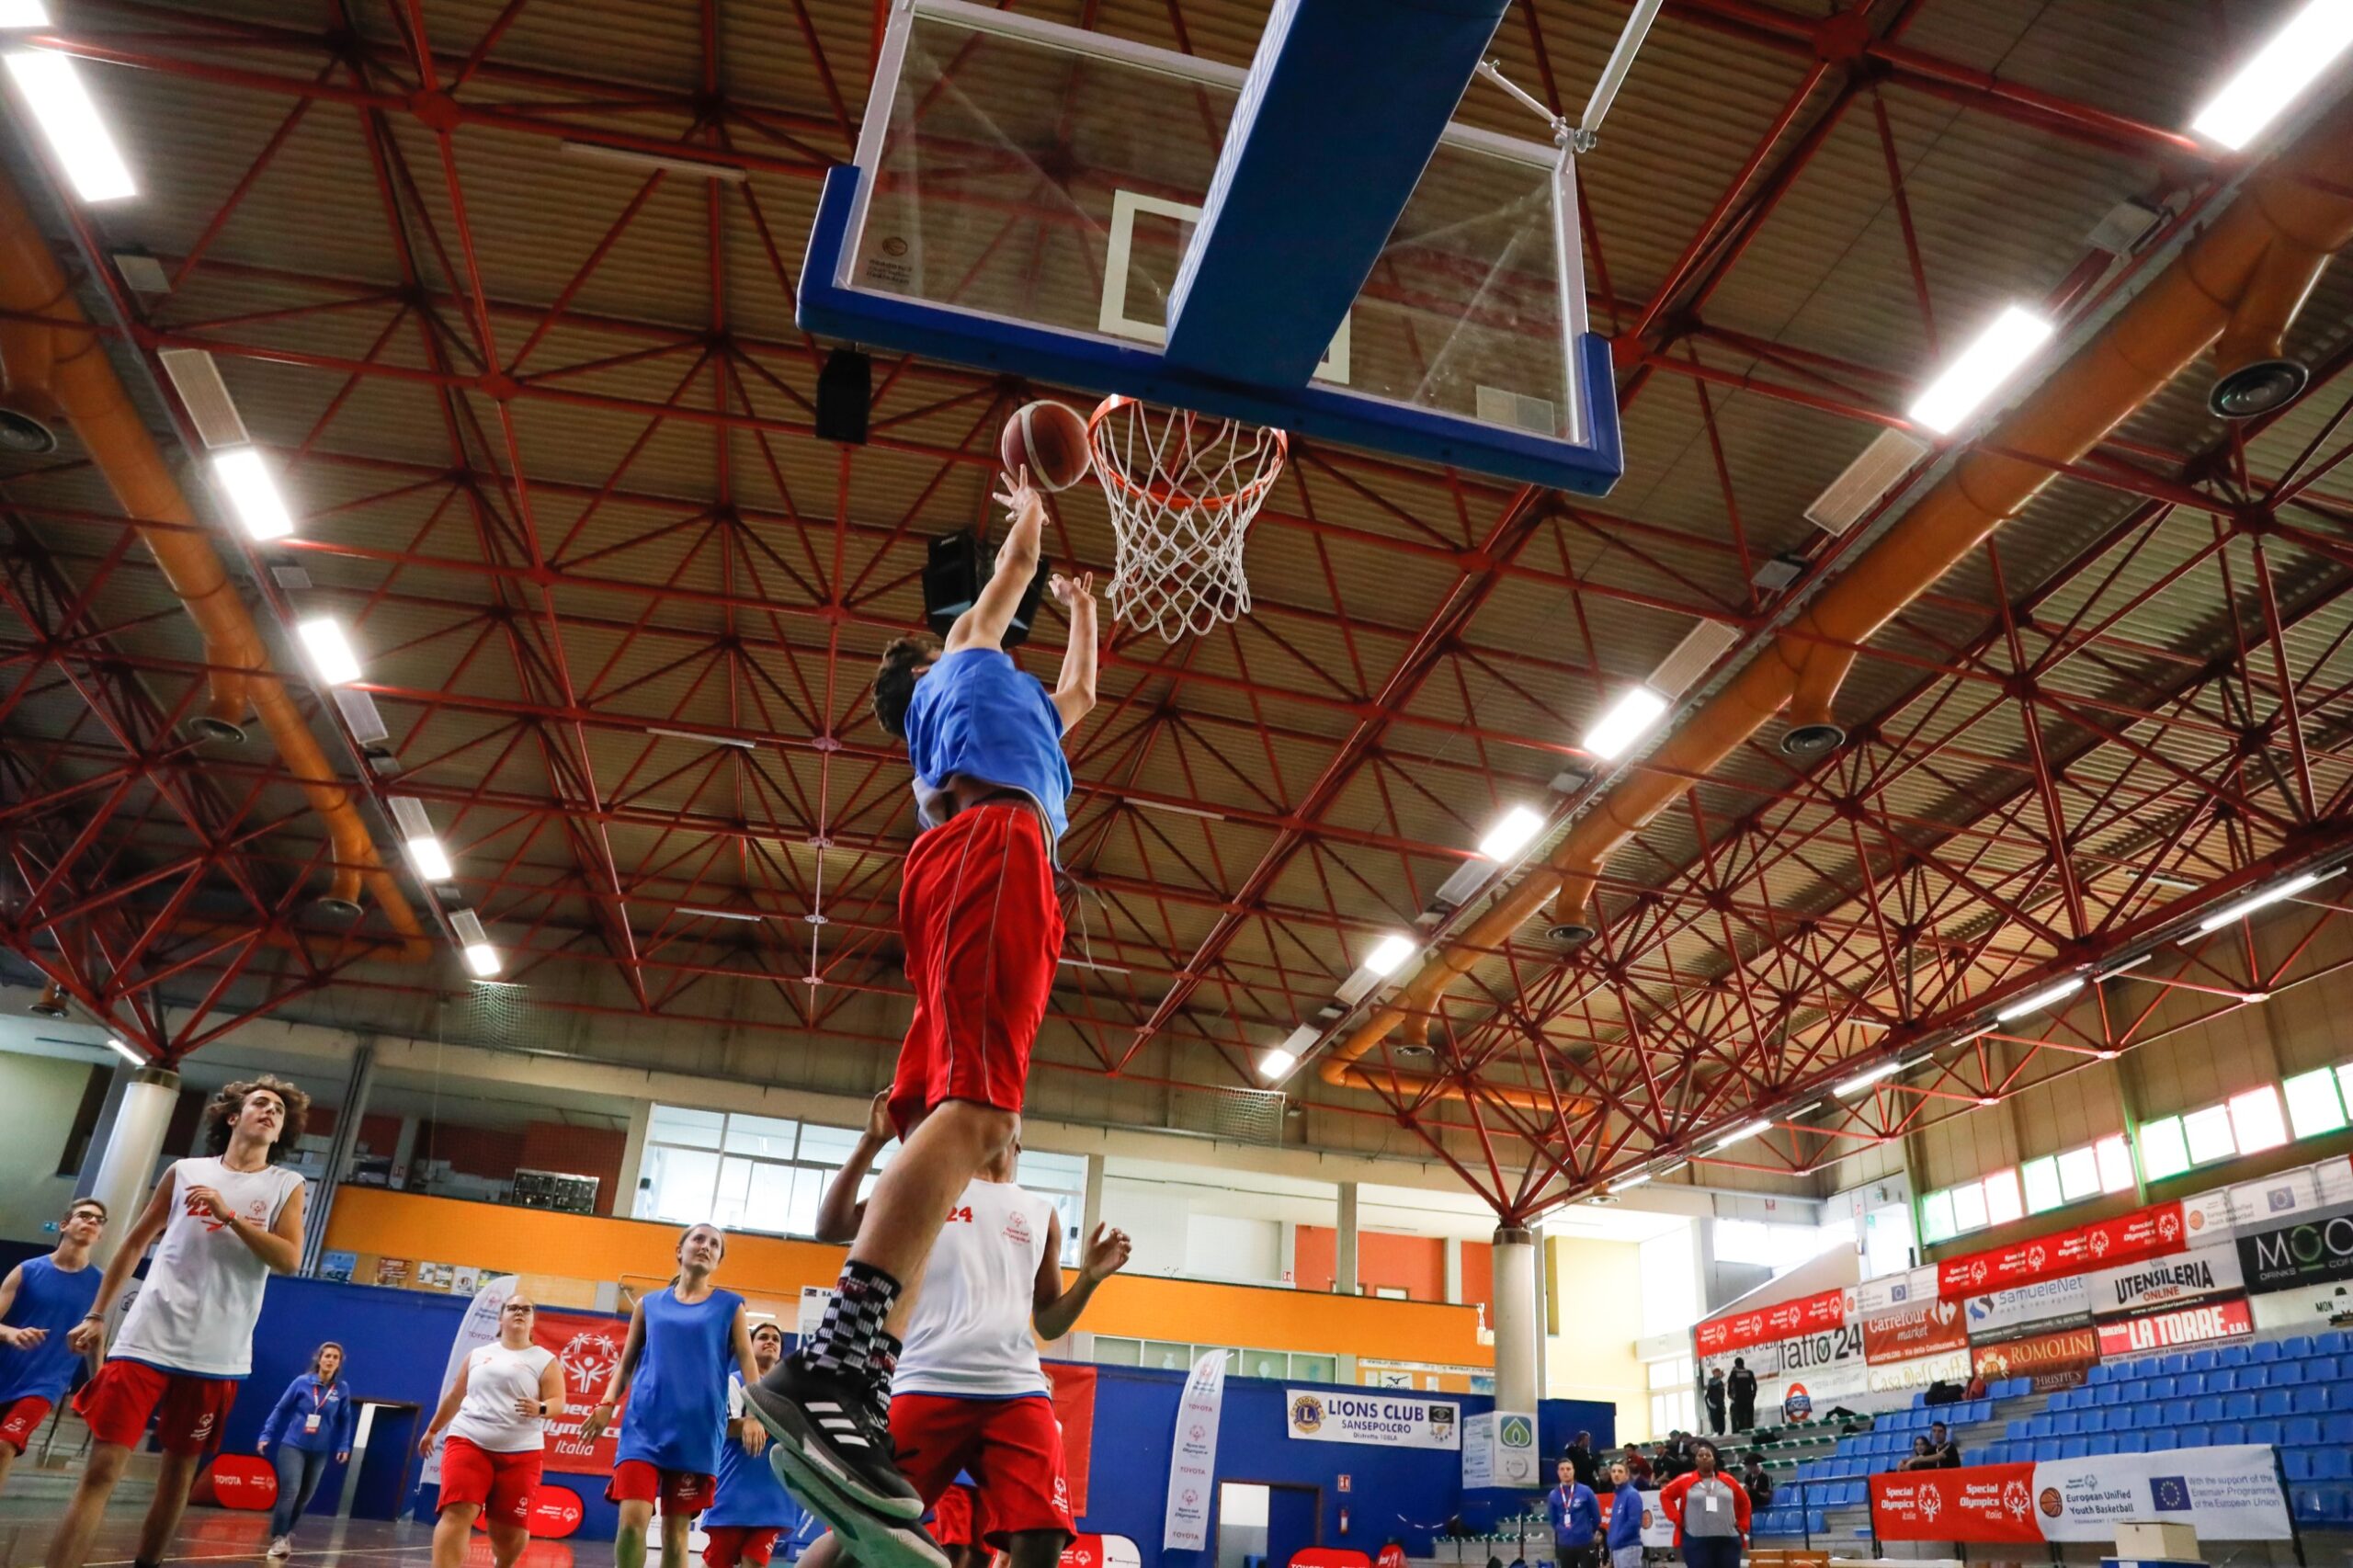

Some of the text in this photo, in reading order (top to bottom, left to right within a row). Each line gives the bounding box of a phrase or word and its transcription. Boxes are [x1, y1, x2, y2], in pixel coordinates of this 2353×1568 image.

[945, 1206, 972, 1222] 24
[2260, 1267, 2297, 1281] DRINKS
[2115, 1260, 2214, 1305] UTENSILERIA
[1999, 1277, 2084, 1305] SamueleNet
[2143, 1286, 2180, 1301] ONLINE
[1869, 1308, 1927, 1333] Carrefour
[1897, 1324, 1928, 1341] market
[2128, 1318, 2155, 1350] LA
[2154, 1306, 2227, 1346] TORRE
[1779, 1333, 1831, 1369] fatto
[1835, 1324, 1862, 1360] 24
[2011, 1334, 2095, 1364] ROMOLINI
[1869, 1369, 1903, 1393] Casa
[1188, 1403, 1213, 1412] TOYOTA
[1328, 1399, 1424, 1422] LIONS CLUB
[1342, 1419, 1411, 1434] SANSEPOLCRO
[554, 1440, 595, 1456] Italia
[1180, 1466, 1206, 1475] TOYOTA
[214, 1474, 242, 1485] TOYOTA
[2188, 1476, 2204, 1485] With
[2205, 1476, 2216, 1484] the
[2218, 1475, 2248, 1484] support
[2249, 1474, 2258, 1483] of
[1886, 1487, 1914, 1497] Special
[1966, 1483, 1998, 1495] Special
[2066, 1489, 2131, 1503] European Unified
[2227, 1486, 2276, 1496] Programme
[1881, 1499, 1915, 1509] Olympics
[1960, 1496, 2000, 1509] Olympics
[2069, 1503, 2134, 1515] Youth Basketball
[2214, 1498, 2251, 1508] European
[2254, 1497, 2279, 1506] Union
[1902, 1511, 1916, 1520] Italia
[1985, 1510, 2003, 1519] Italia
[1173, 1531, 1199, 1540] TOYOTA
